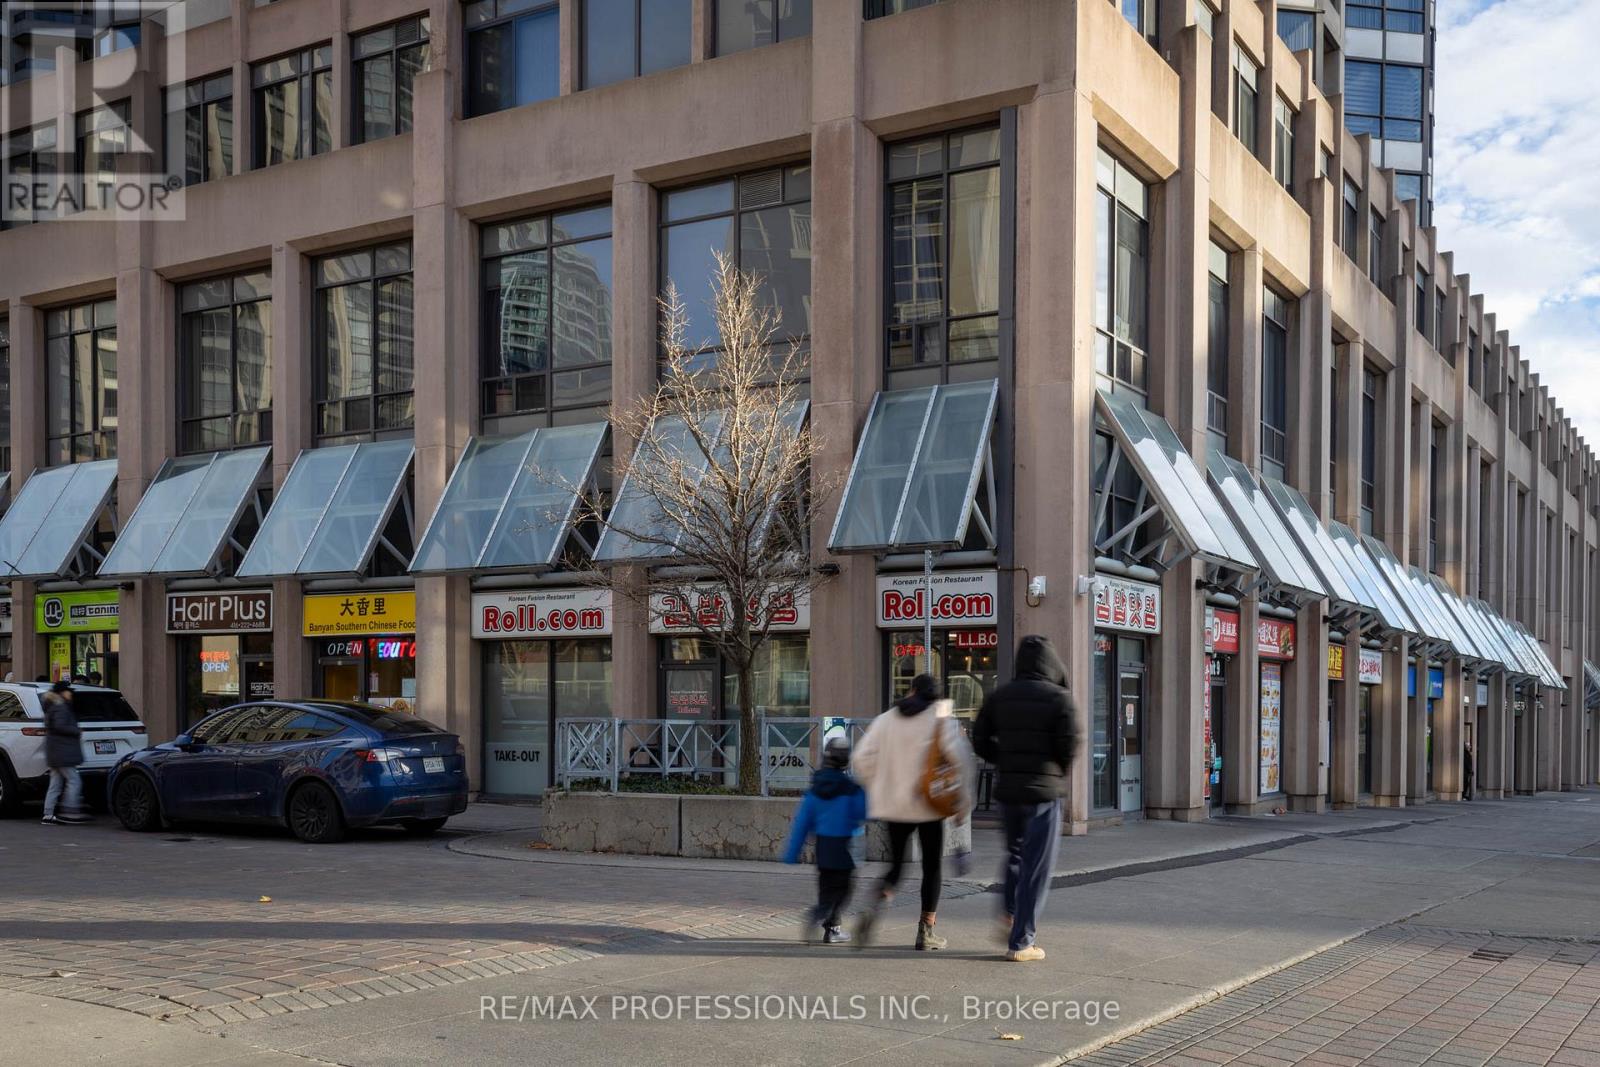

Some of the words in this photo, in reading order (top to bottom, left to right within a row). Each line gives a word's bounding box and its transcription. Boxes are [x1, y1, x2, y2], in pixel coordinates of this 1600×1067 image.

[893, 578, 917, 586] Korean
[944, 575, 983, 584] Restaurant
[546, 593, 576, 601] Restaurant
[882, 588, 994, 621] Rol.com
[172, 597, 217, 621] Hair
[220, 595, 266, 621] Plus
[340, 597, 387, 616] 大香里
[662, 591, 798, 628] 김밥컴
[482, 604, 605, 632] Roll.com
[309, 623, 334, 633] Banyan
[336, 622, 367, 631] Southern
[369, 620, 397, 630] Chinese
[327, 641, 363, 656] OPEN
[202, 662, 229, 672] OPEN
[494, 750, 540, 762] TAKE-OUT
